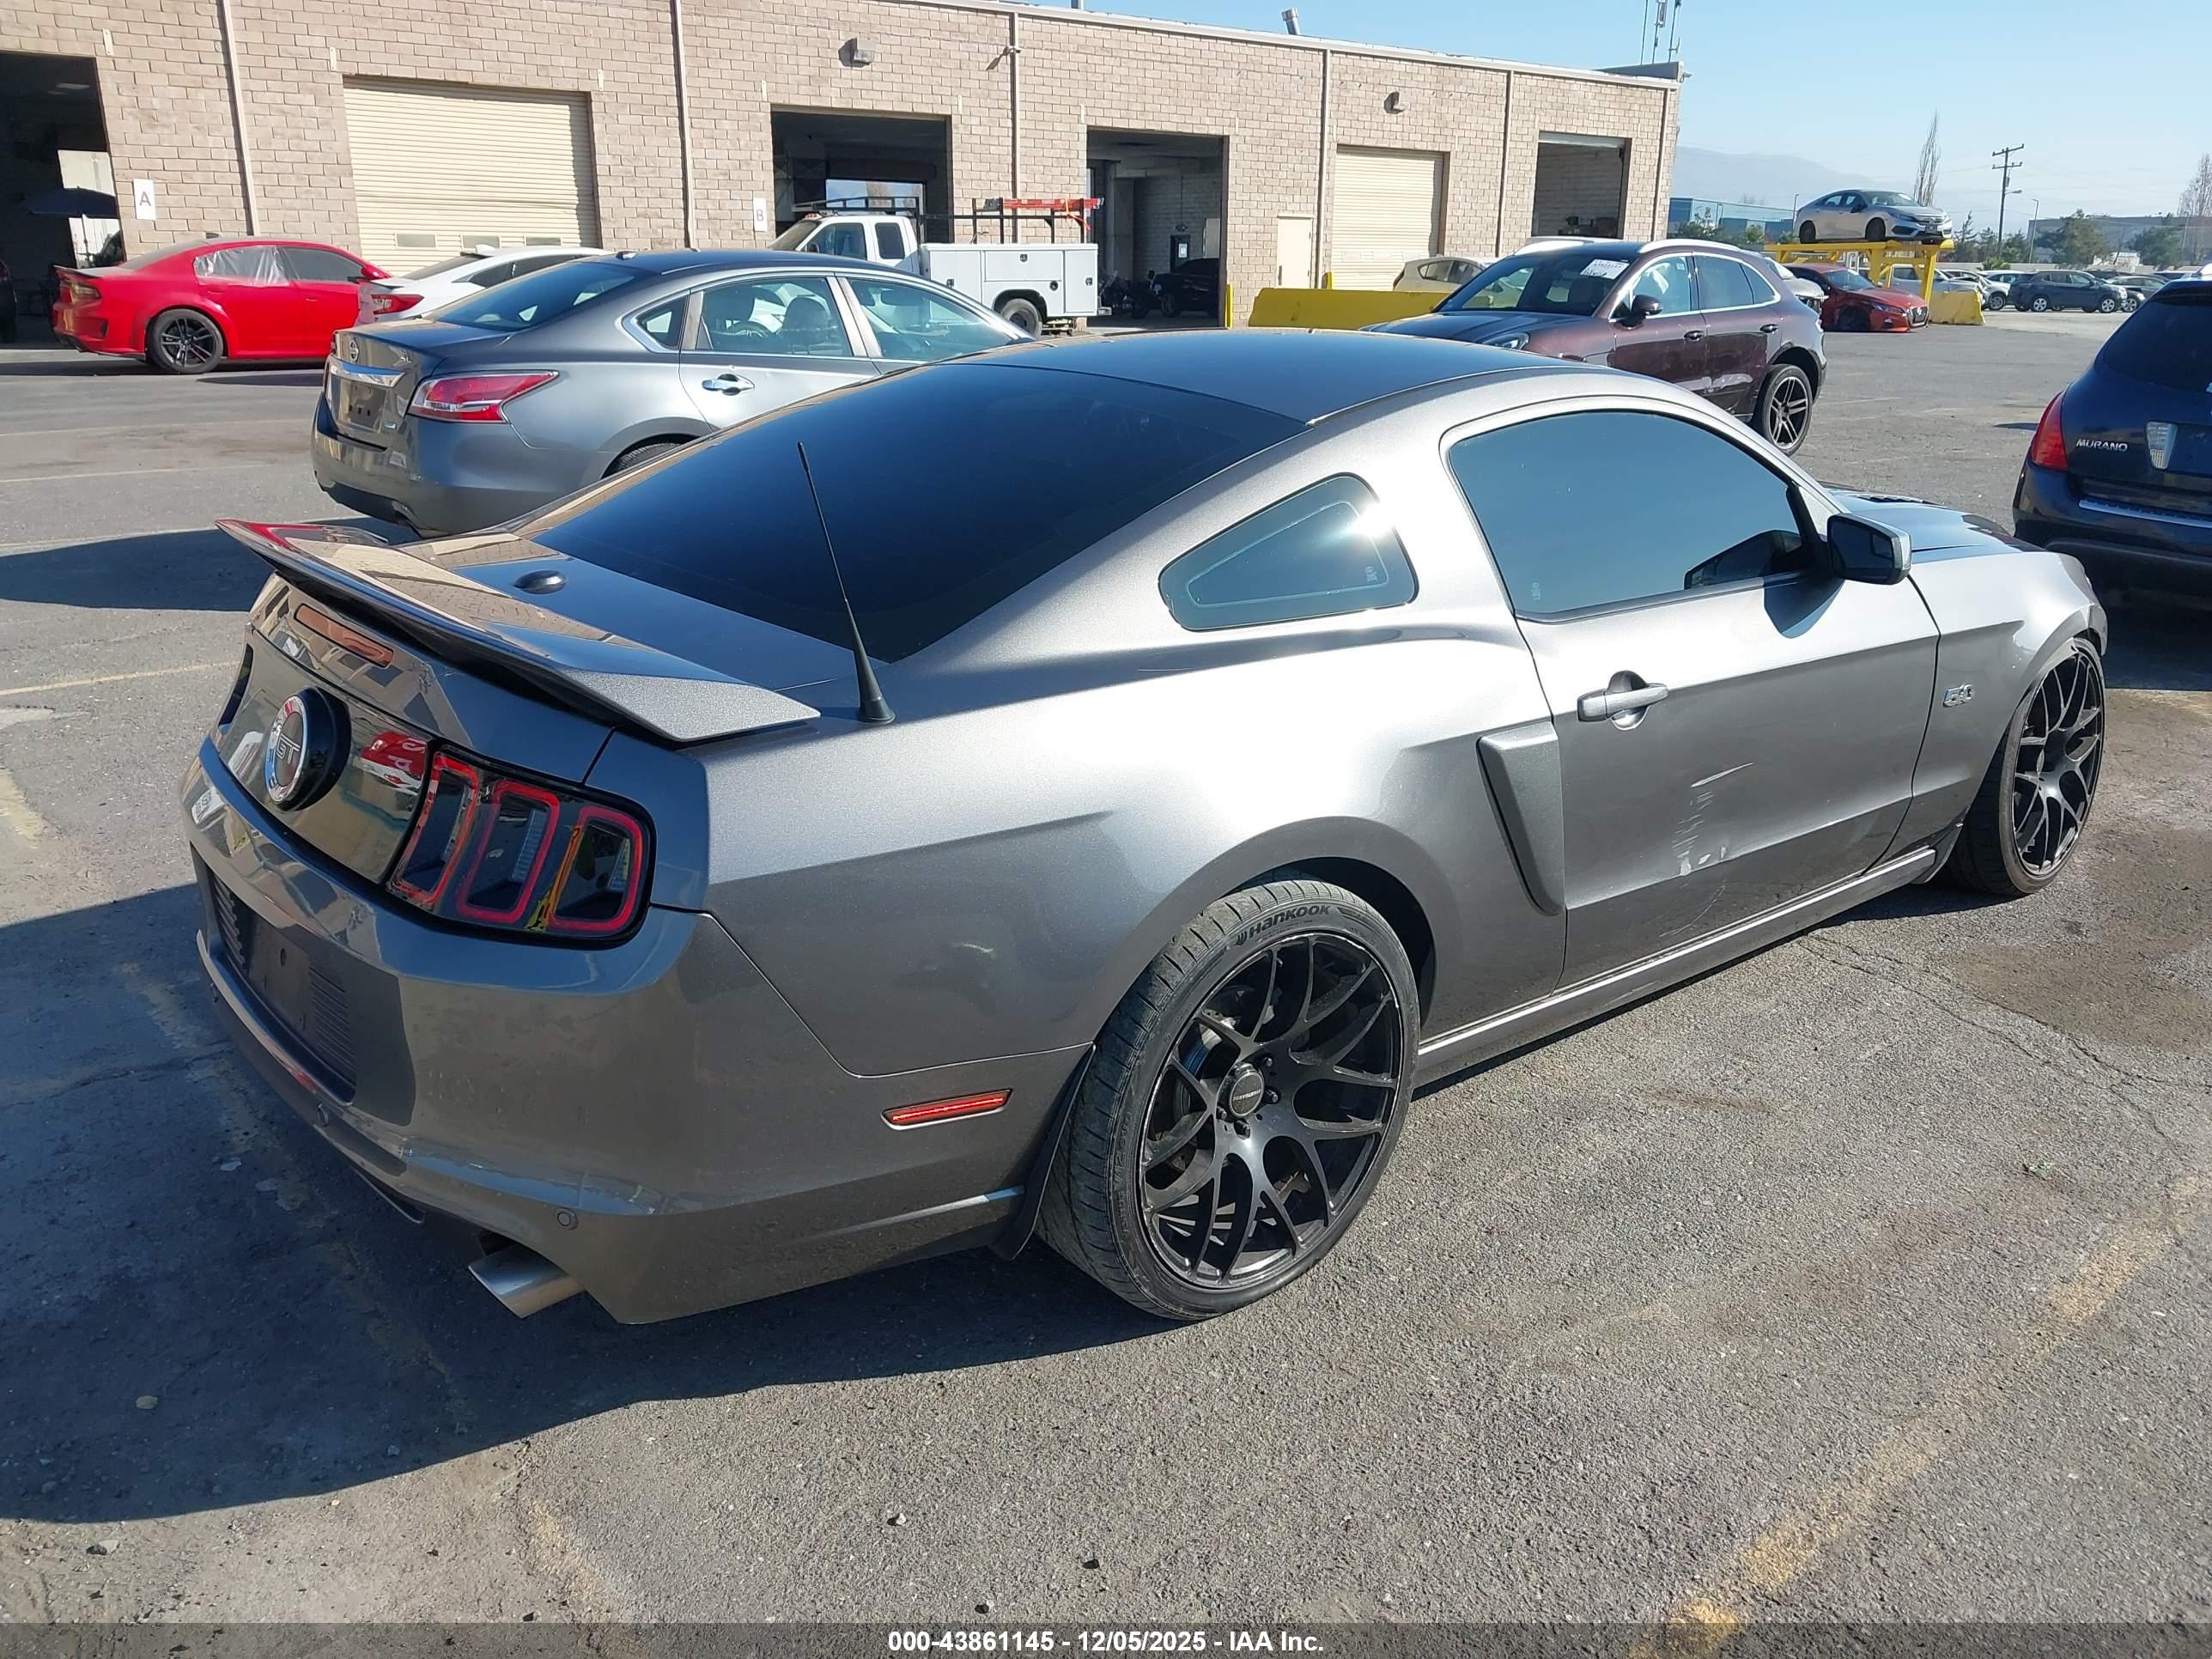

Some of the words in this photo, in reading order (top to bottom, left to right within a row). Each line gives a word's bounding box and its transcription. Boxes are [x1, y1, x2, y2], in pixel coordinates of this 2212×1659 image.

[138, 191, 152, 207] A
[756, 209, 764, 221] B
[2075, 438, 2129, 453] MURANO
[276, 733, 301, 765] GT
